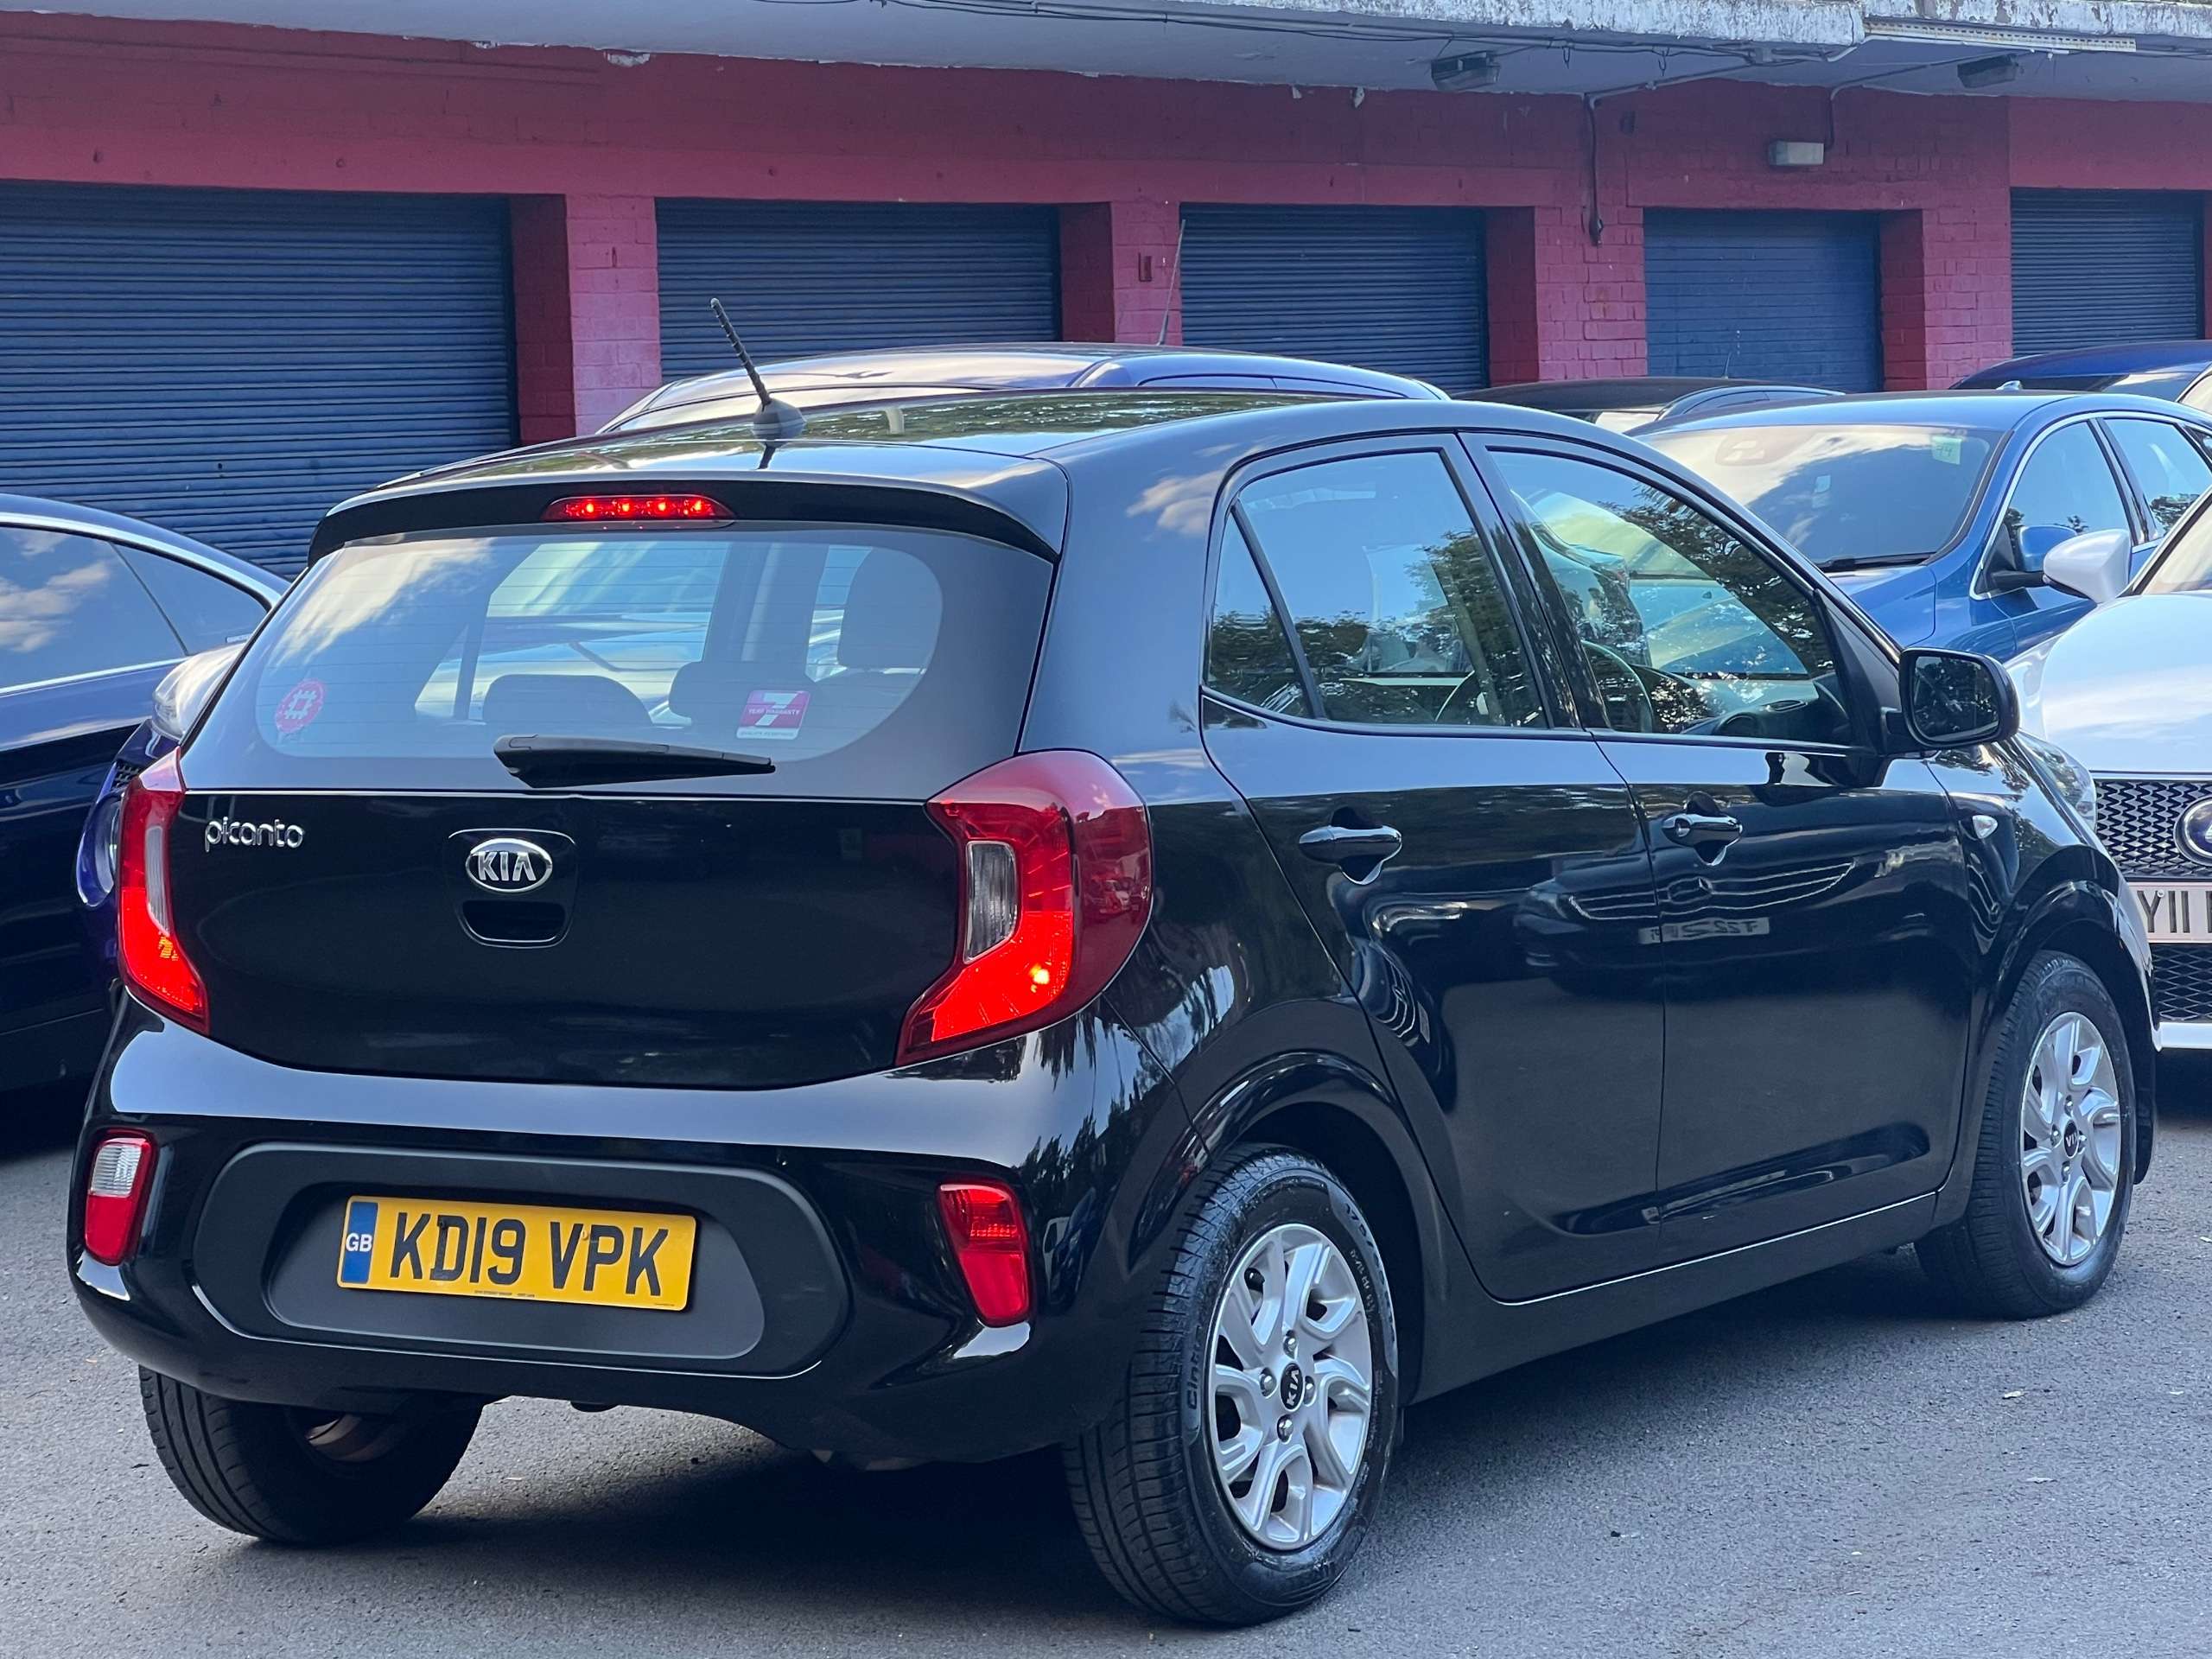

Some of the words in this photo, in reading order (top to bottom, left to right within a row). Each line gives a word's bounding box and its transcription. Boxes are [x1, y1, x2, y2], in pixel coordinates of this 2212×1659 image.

[205, 817, 304, 852] picanto
[478, 851, 537, 881] KIA
[346, 1232, 372, 1252] GB
[390, 1211, 525, 1286] KD19
[550, 1221, 669, 1296] VPK
[1286, 1369, 1300, 1406] KIA
